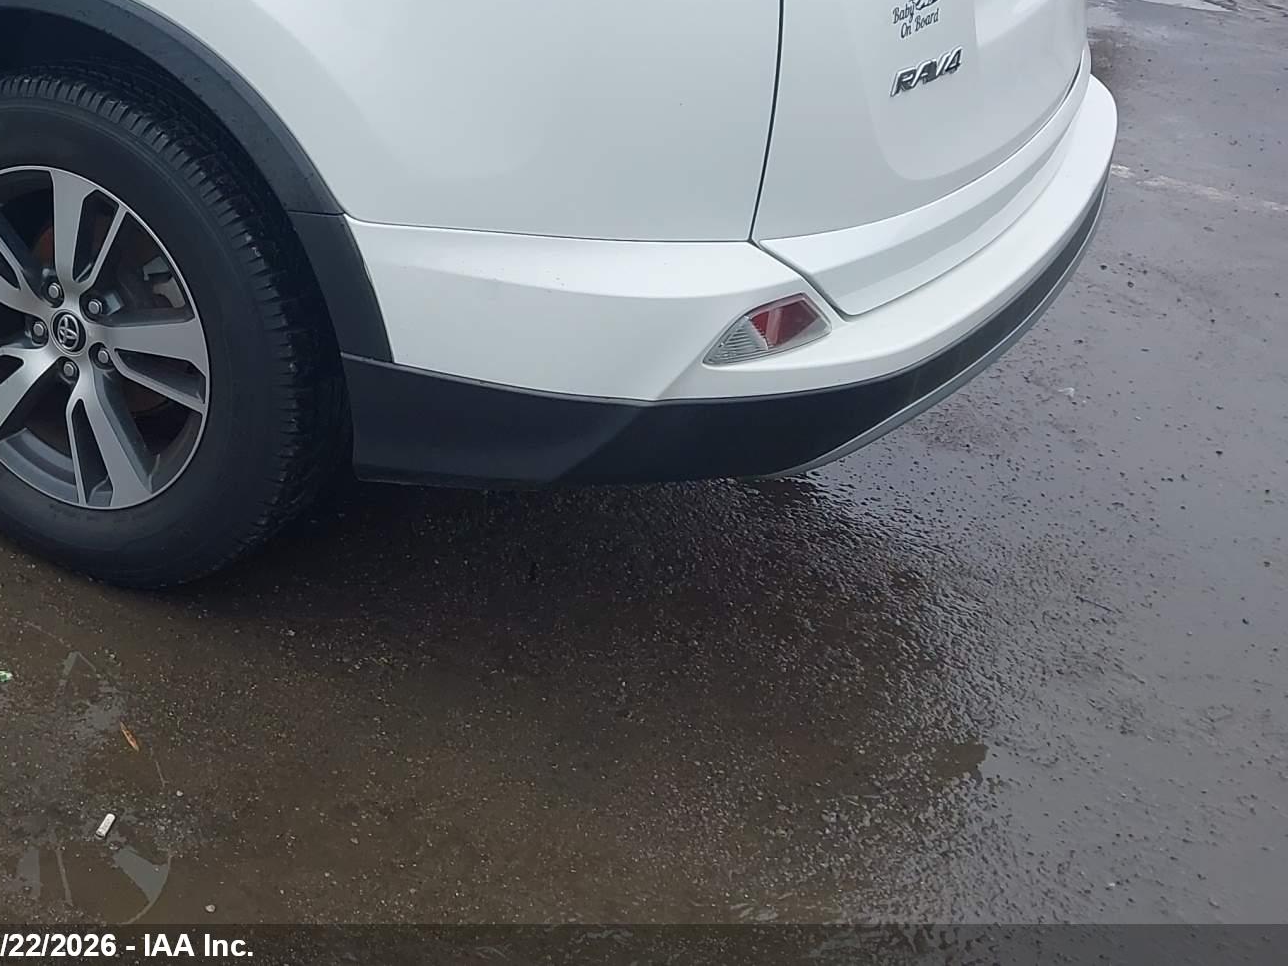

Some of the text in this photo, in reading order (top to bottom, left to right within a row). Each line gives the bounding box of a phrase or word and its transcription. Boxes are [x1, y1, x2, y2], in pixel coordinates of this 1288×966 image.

[893, 2, 914, 24] Baby
[901, 8, 939, 38] On Board
[890, 46, 962, 97] RAV4
